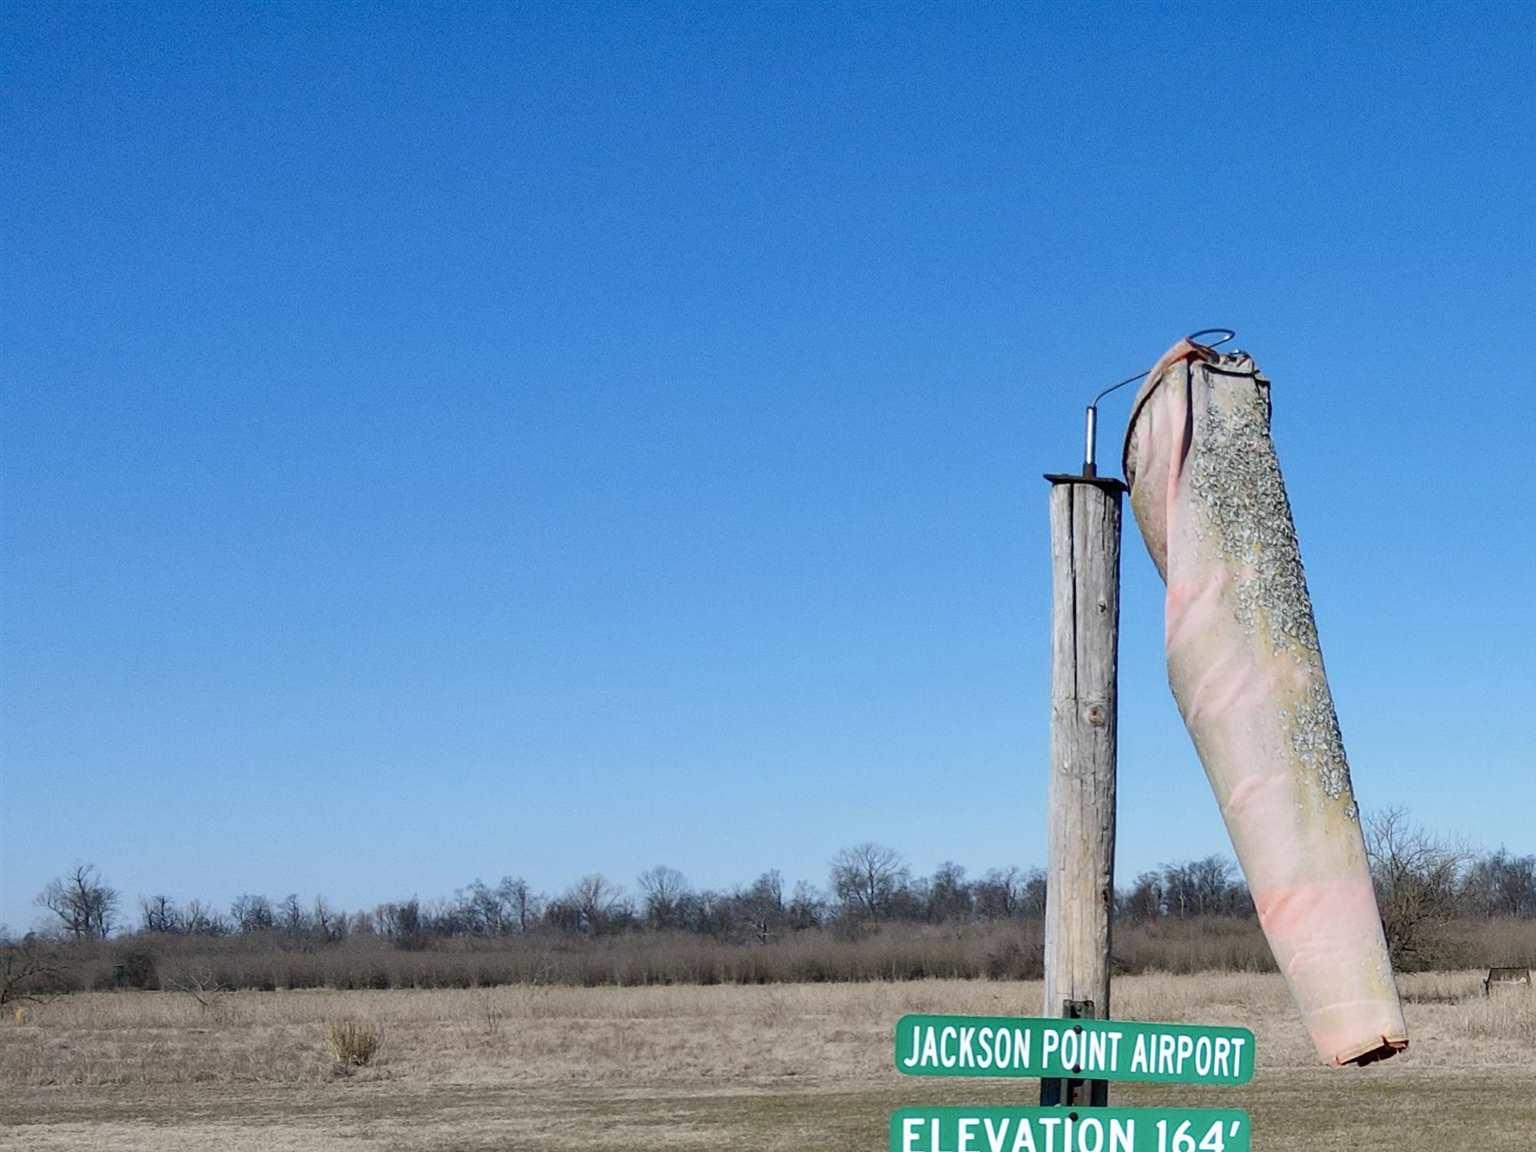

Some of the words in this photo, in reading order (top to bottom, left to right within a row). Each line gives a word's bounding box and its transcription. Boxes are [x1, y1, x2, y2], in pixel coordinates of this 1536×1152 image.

[903, 1025, 1032, 1069] JACKSON
[1042, 1028, 1122, 1072] POINT
[1130, 1032, 1245, 1077] AIRPORT
